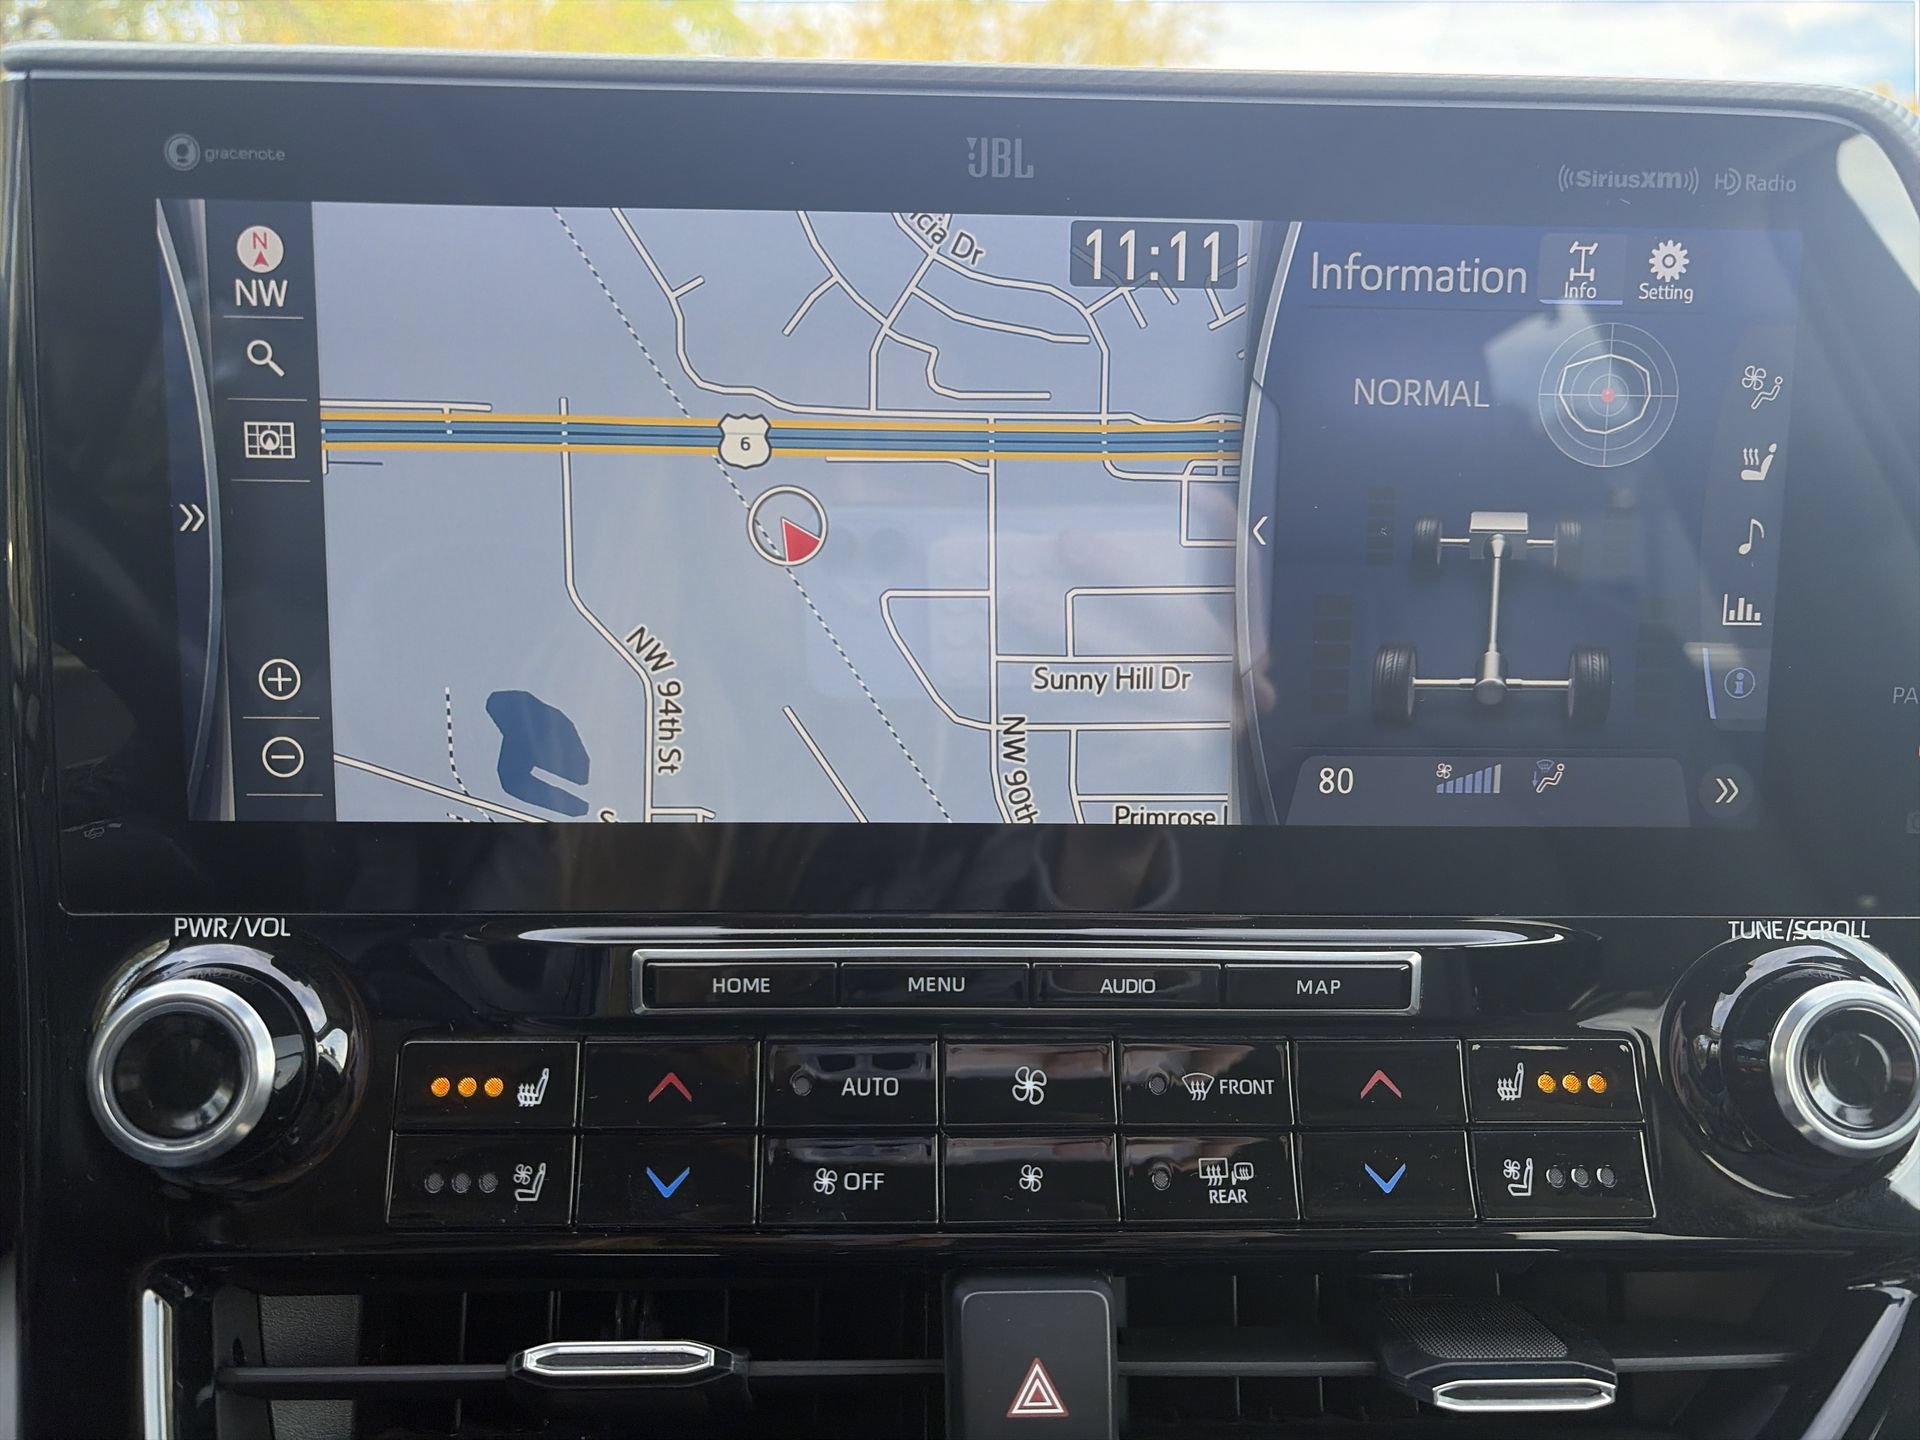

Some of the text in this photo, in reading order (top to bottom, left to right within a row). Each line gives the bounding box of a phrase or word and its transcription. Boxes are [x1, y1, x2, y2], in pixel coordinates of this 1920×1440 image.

[204, 147, 286, 162] gracenote
[966, 136, 1034, 179] JBL
[1745, 173, 1797, 193] Radio
[252, 231, 268, 250] N
[950, 231, 984, 266] Dr
[1085, 228, 1222, 283] 11:11
[1311, 251, 1528, 294] Information
[234, 278, 289, 308] NW
[1564, 281, 1598, 300] Info
[1638, 283, 1694, 304] Setting
[1353, 378, 1490, 408] NORMAL
[740, 436, 751, 451] 6
[1033, 666, 1192, 695] Sunny Hill Dr
[625, 625, 683, 774] NW 94th St
[1002, 716, 1039, 824] NW 90th
[1317, 767, 1354, 795] 80
[1115, 805, 1217, 825] Primrose
[174, 916, 291, 940] PWR/VOL
[1727, 918, 1872, 942] TUNE/SCROLL
[712, 977, 771, 994] HOME
[907, 976, 966, 993] MENU
[1099, 977, 1157, 995] AUDIO
[1295, 979, 1342, 996] MAP
[840, 1076, 900, 1097] AUTO
[1218, 1078, 1275, 1096] FRONT
[843, 1171, 885, 1191] OFF
[1208, 1188, 1248, 1205] REAR
